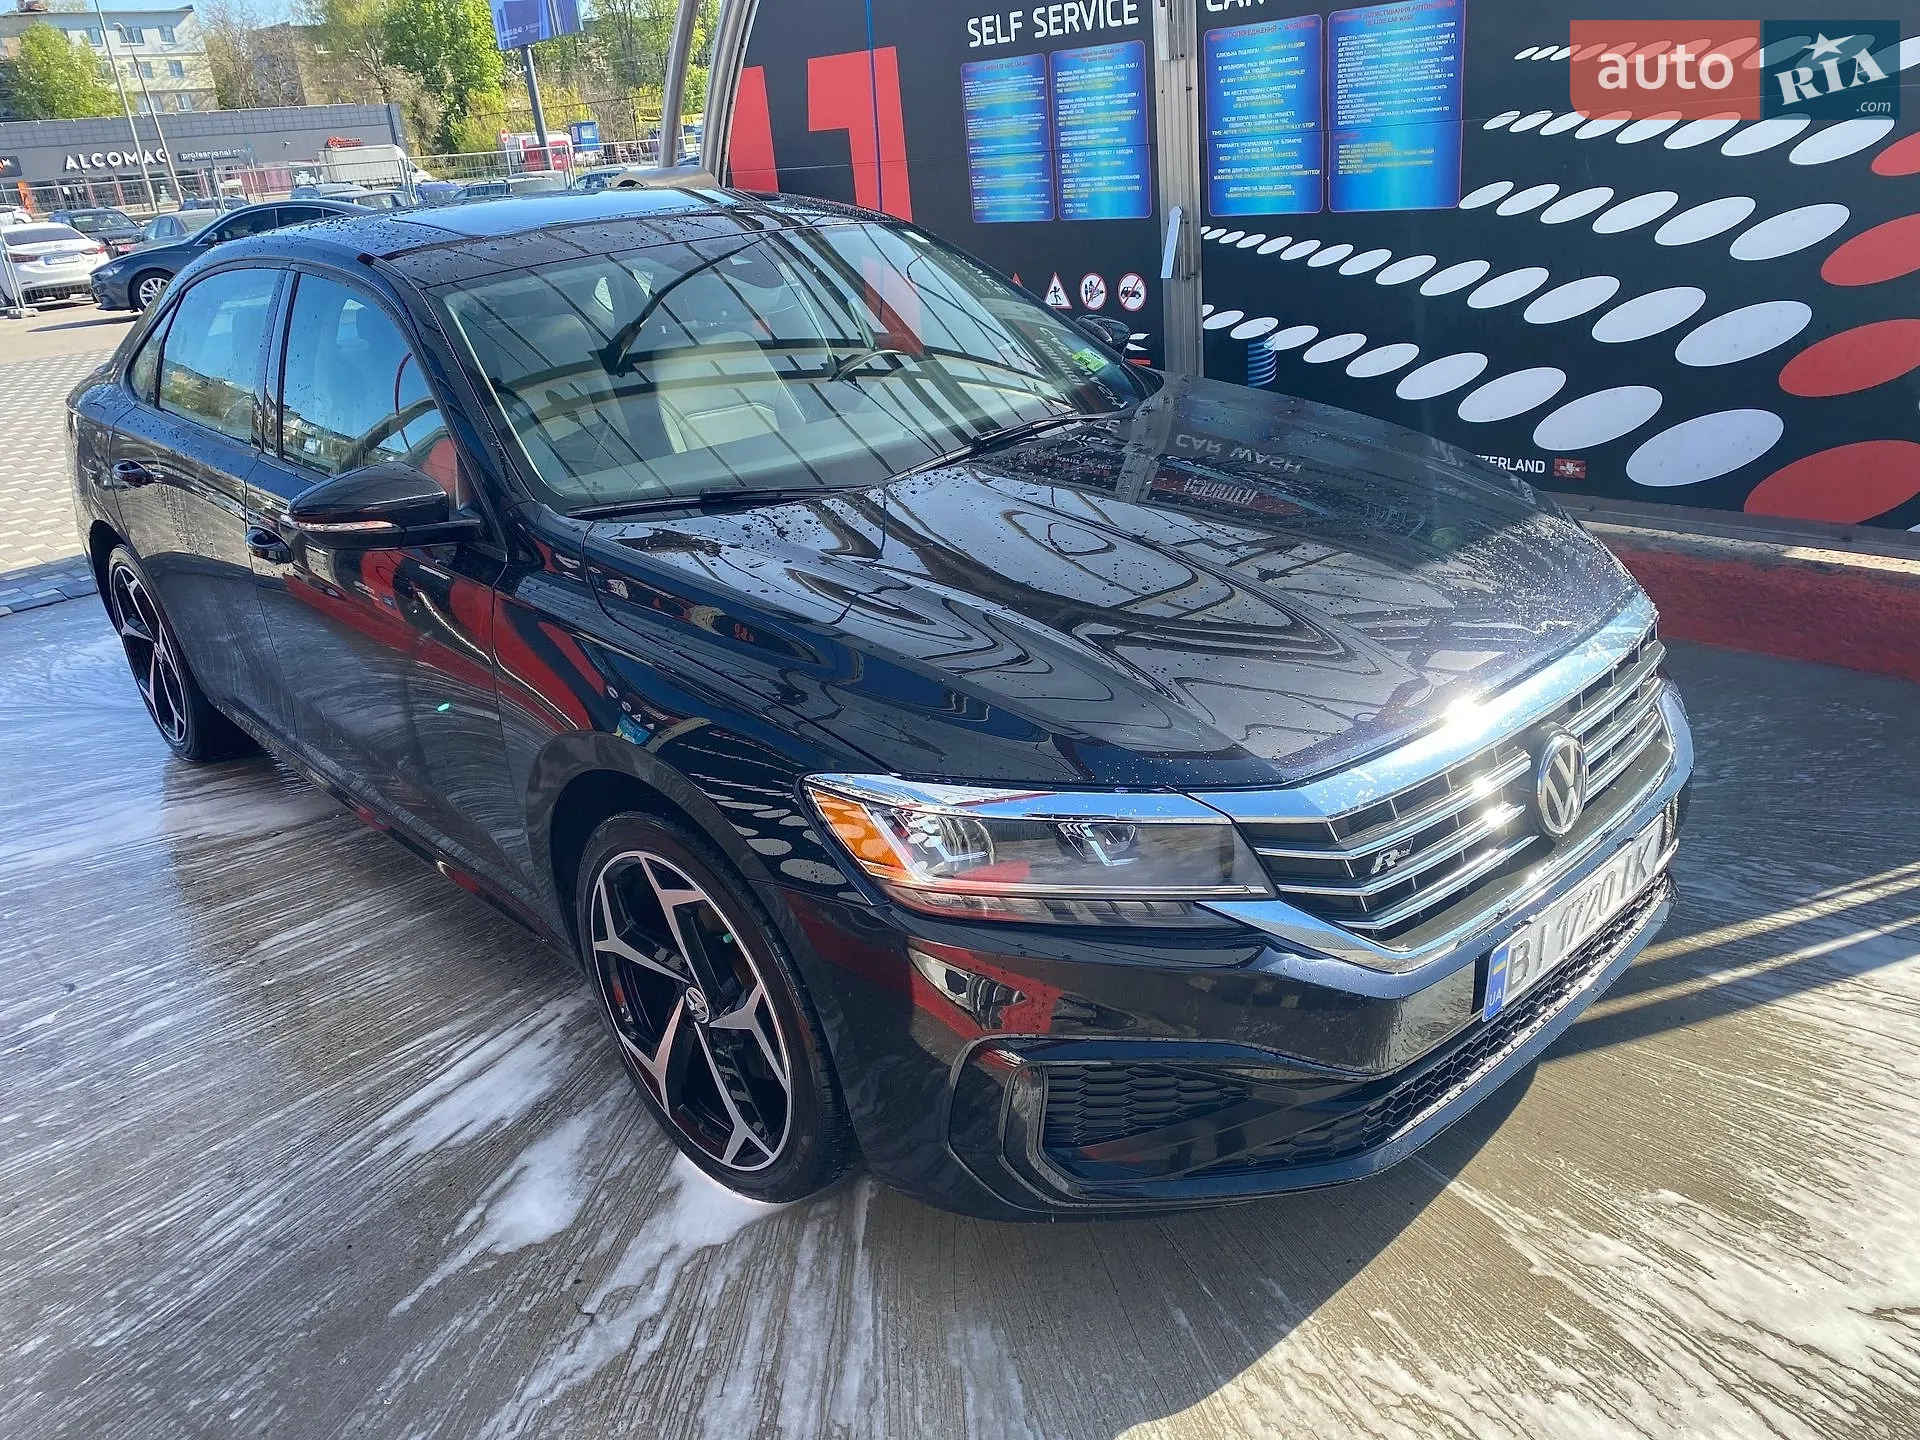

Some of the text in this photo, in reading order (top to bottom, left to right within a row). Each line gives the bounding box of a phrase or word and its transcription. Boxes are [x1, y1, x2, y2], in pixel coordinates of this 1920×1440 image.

[967, 0, 1140, 48] SELF SERVICE
[1475, 454, 1547, 475] ERLAND
[1488, 986, 1503, 1007] UA
